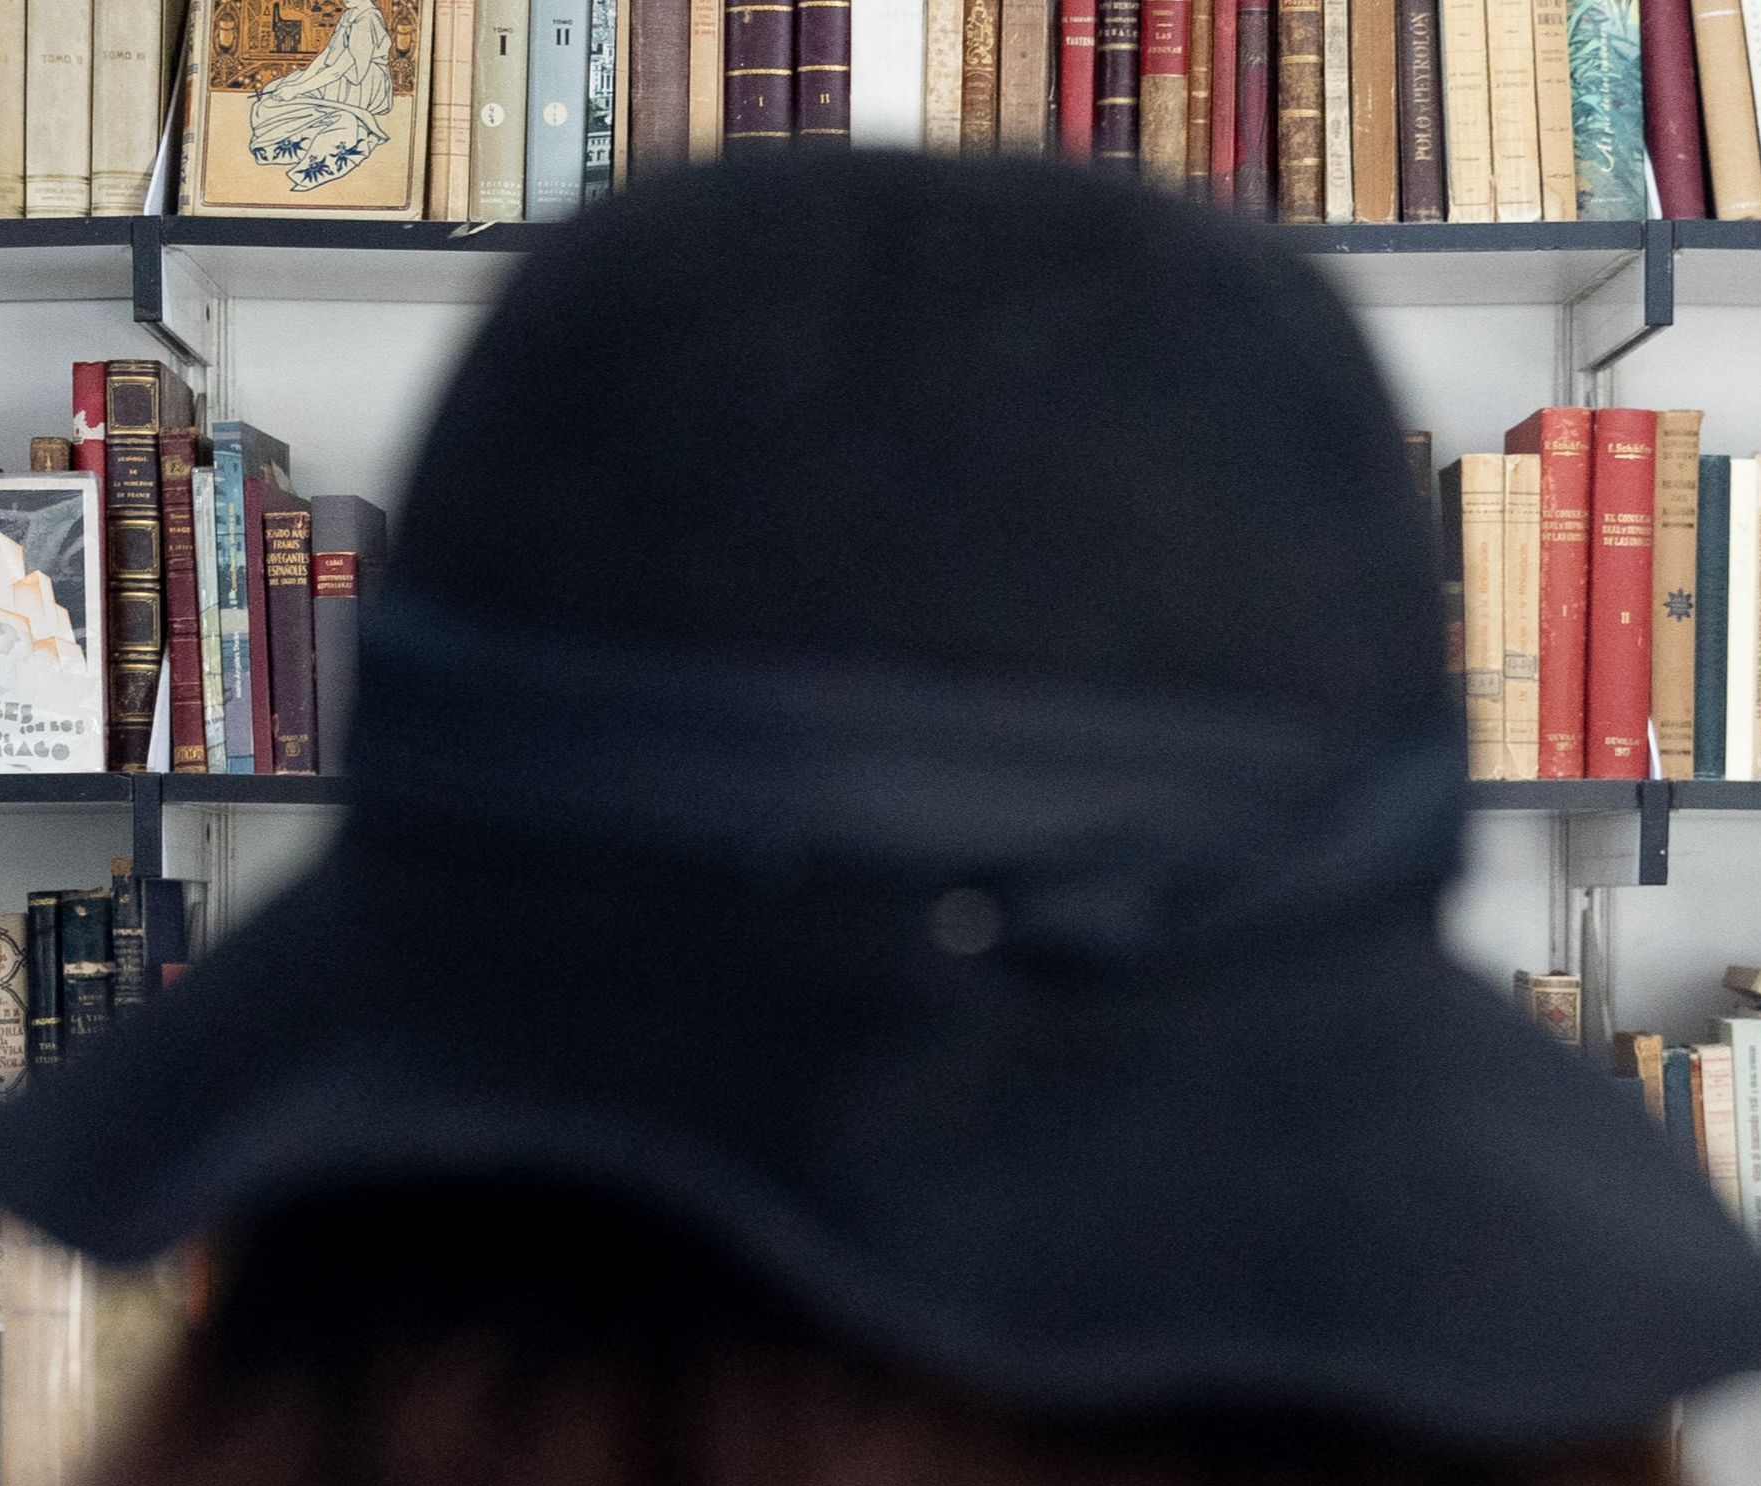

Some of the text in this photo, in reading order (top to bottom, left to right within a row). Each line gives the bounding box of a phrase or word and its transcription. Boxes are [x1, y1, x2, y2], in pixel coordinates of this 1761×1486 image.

[556, 28, 570, 45] II
[500, 35, 507, 55] I
[1415, 116, 1432, 161] POLO
[267, 566, 308, 577] ESPAÑOLES
[1621, 612, 1630, 623] II
[50, 720, 85, 735] LOS
